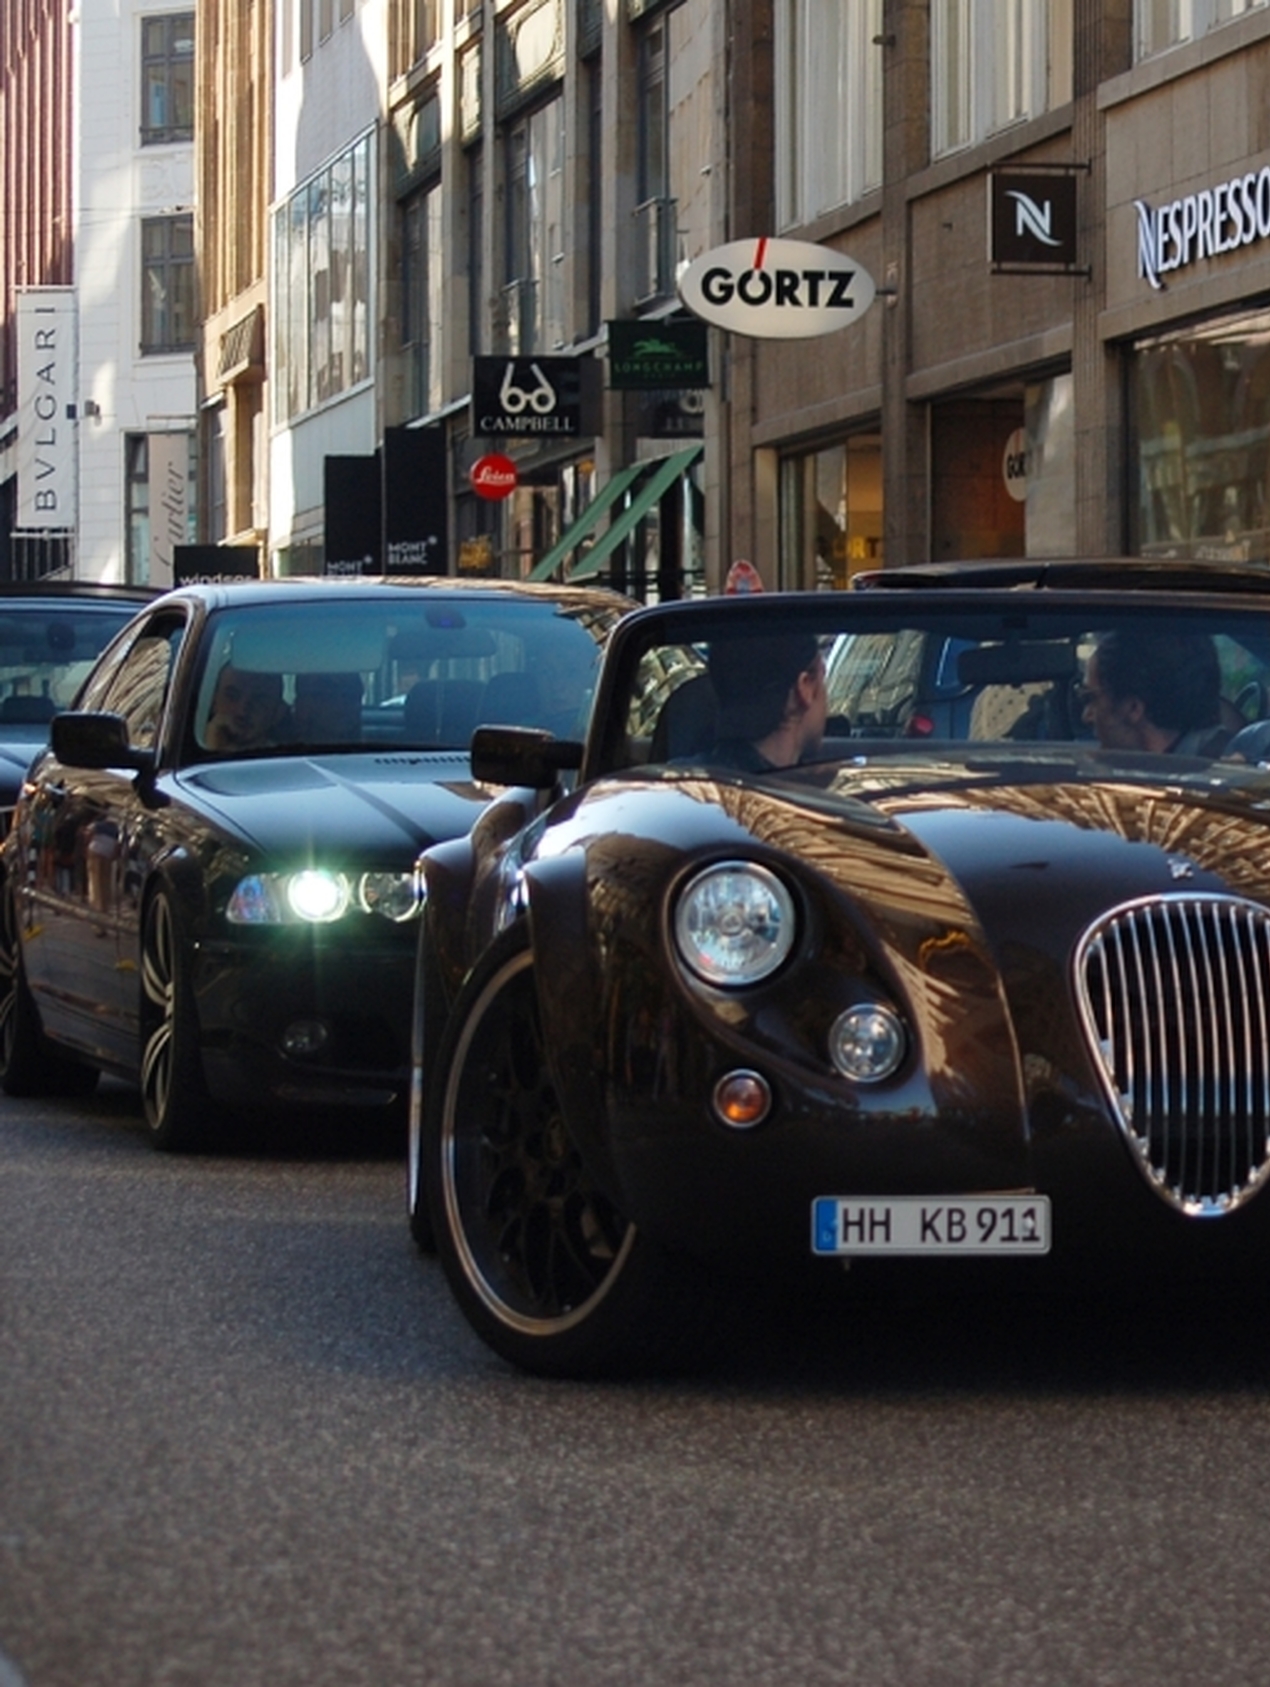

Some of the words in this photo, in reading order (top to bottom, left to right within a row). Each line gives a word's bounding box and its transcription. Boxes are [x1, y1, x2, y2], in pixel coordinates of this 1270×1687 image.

[1004, 190, 1063, 246] N
[614, 361, 704, 373] LONGCHAMP
[34, 306, 56, 512] BVLGARI
[480, 416, 575, 432] CAMPBELL
[475, 465, 516, 487] Leica
[387, 541, 428, 553] MONT
[387, 553, 429, 565] BLANC
[842, 1207, 892, 1243] HH
[921, 1207, 968, 1243] KB
[976, 1207, 1041, 1243] 911
